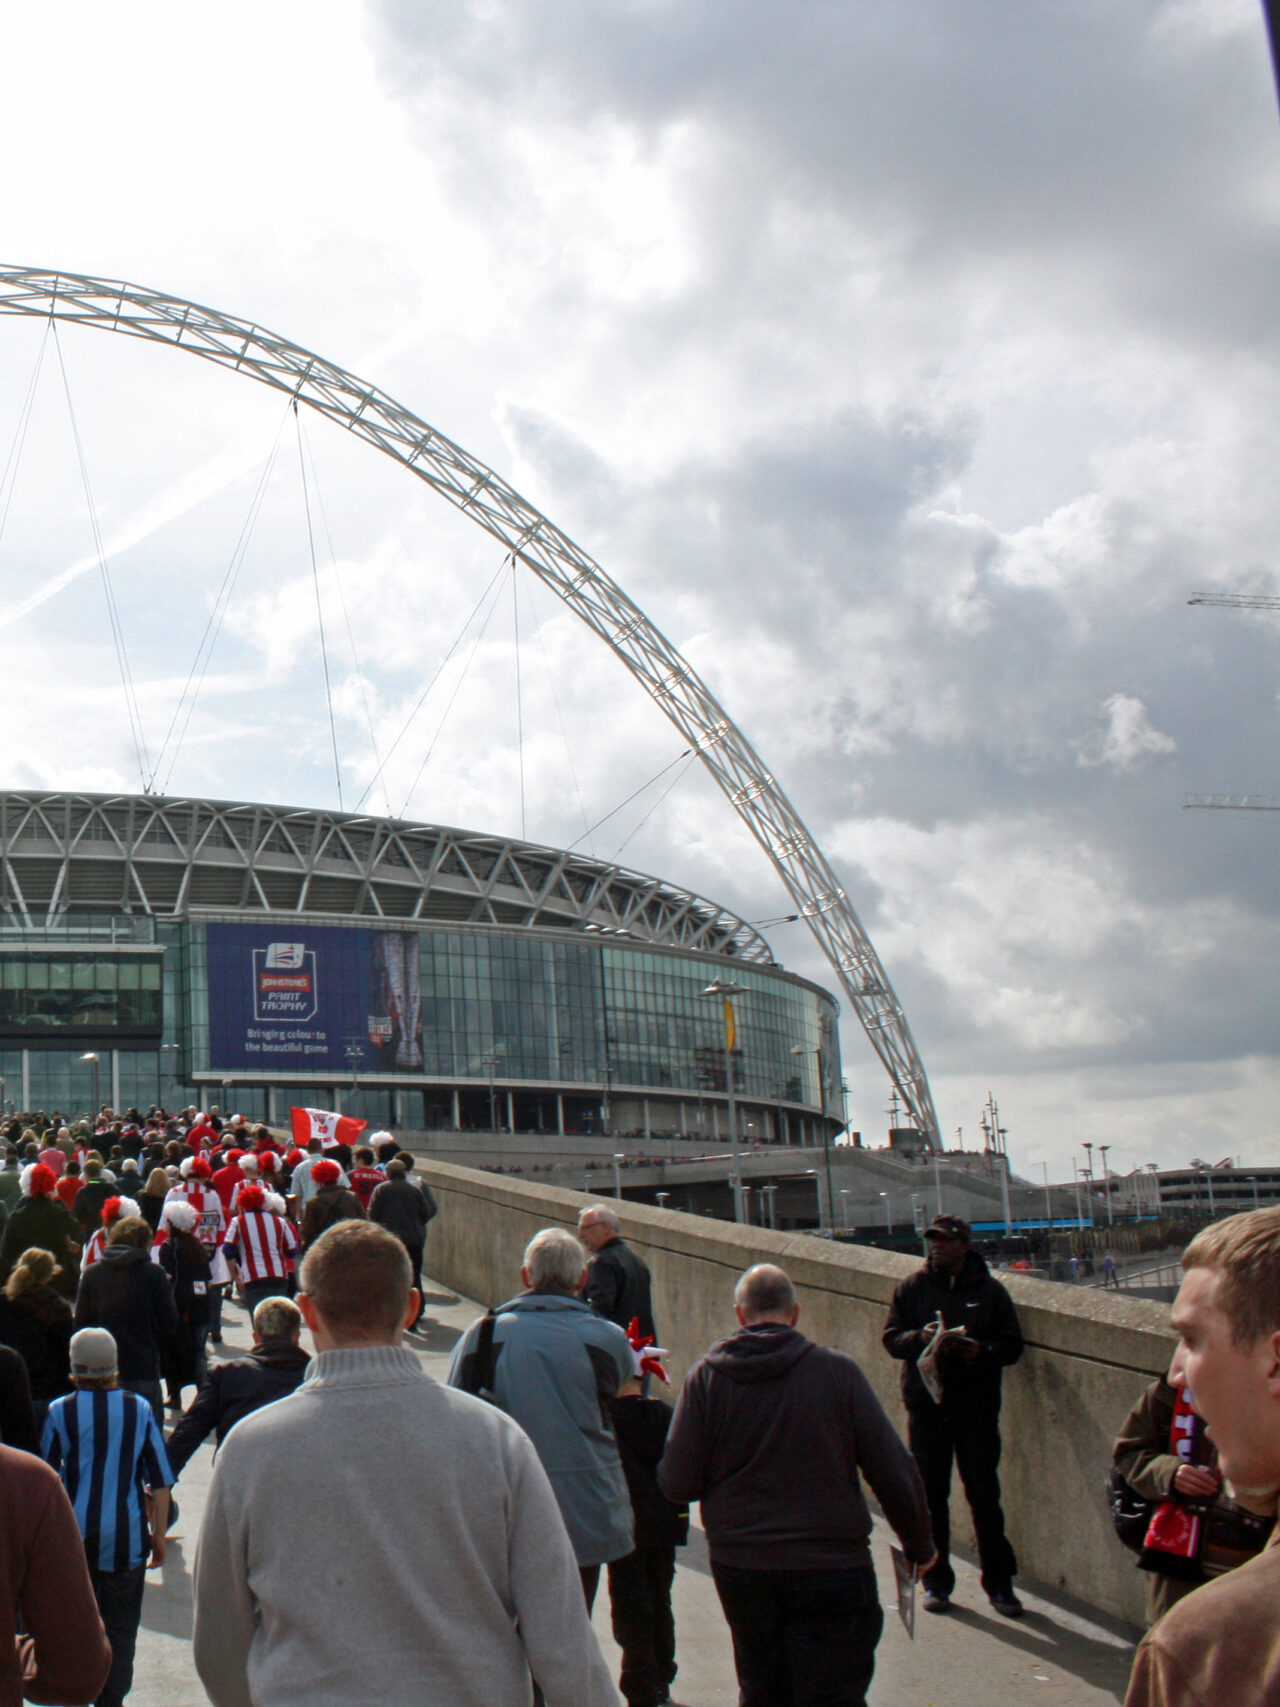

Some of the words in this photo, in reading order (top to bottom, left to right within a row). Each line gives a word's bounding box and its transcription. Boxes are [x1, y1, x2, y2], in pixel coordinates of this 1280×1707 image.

[268, 992, 301, 1001] PAINT
[261, 1001, 307, 1011] TROPHY
[247, 1028, 286, 1041] Bringing
[287, 1029, 315, 1039] colour
[316, 1030, 326, 1040] to
[245, 1042, 260, 1052] the
[262, 1042, 302, 1052] beautiful
[303, 1045, 328, 1055] game
